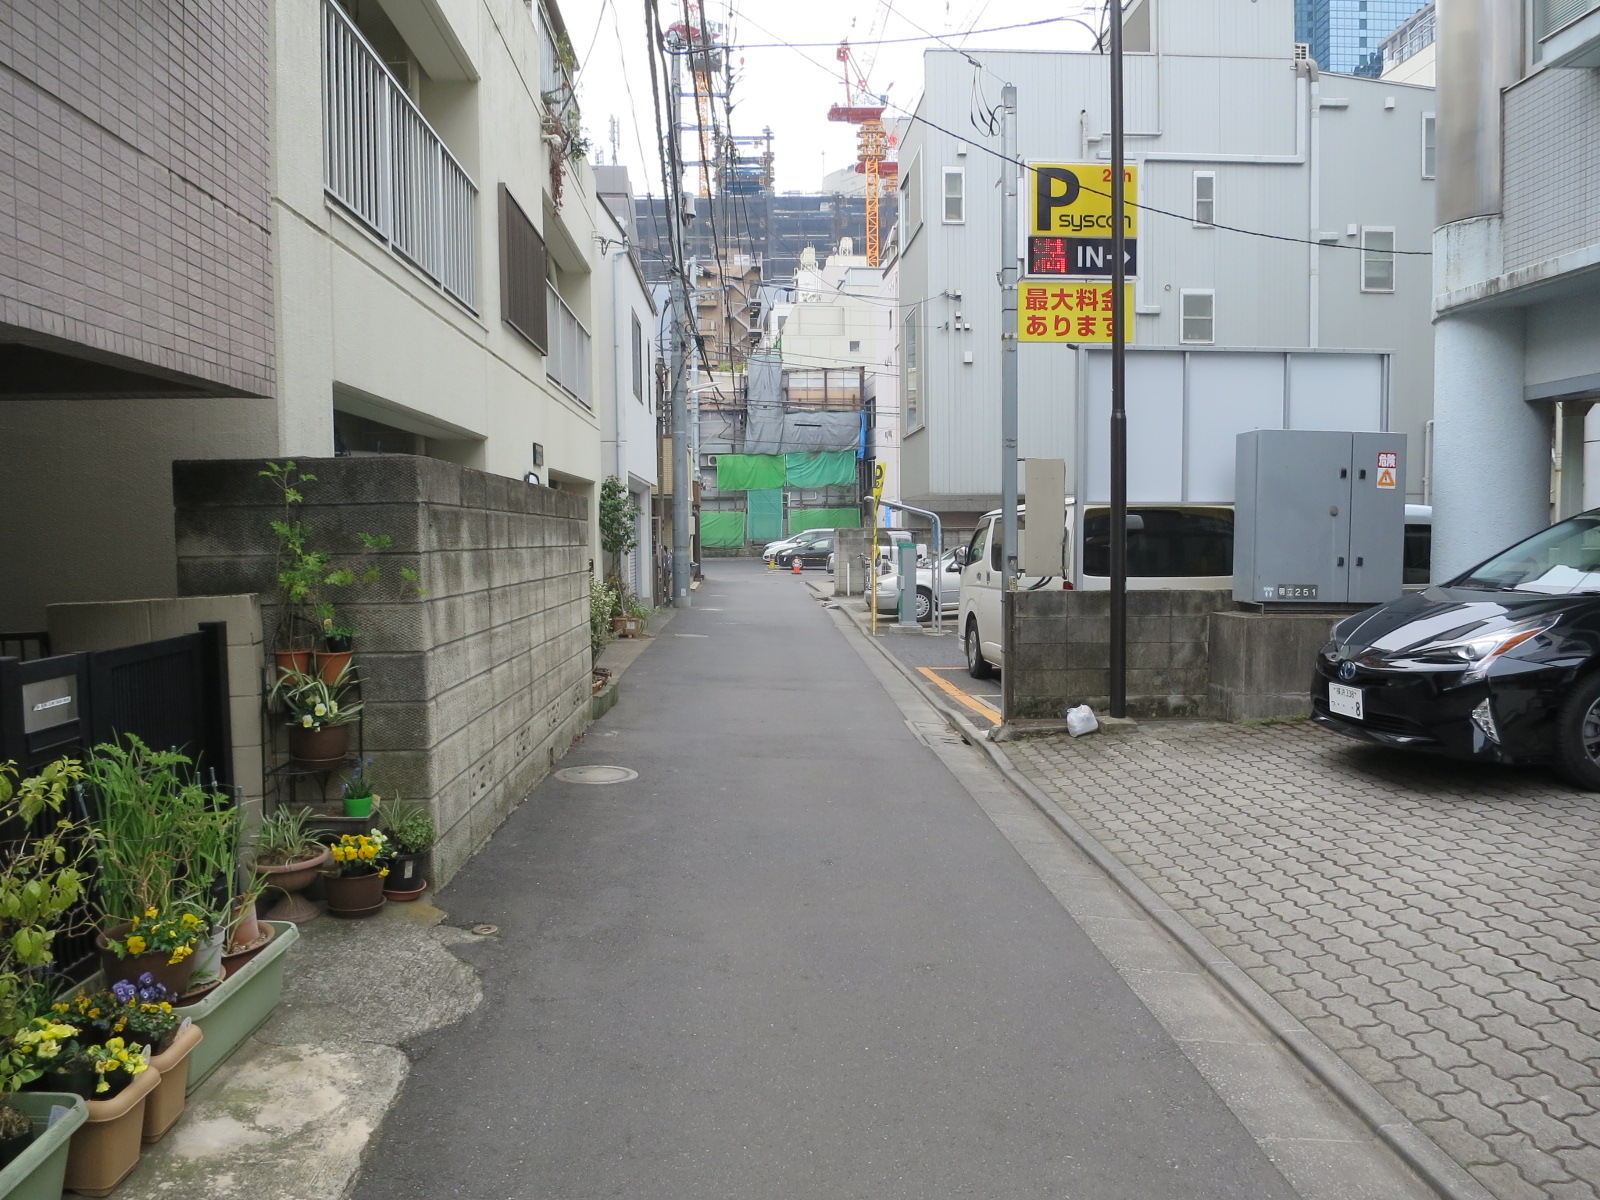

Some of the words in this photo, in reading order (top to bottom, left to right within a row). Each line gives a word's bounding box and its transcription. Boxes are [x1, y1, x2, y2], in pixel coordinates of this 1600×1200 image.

[1102, 168, 1132, 183] 2h
[1037, 167, 1080, 231] P
[1033, 238, 1066, 273] 満
[1077, 245, 1104, 268] IN
[1378, 453, 1396, 467] 危険
